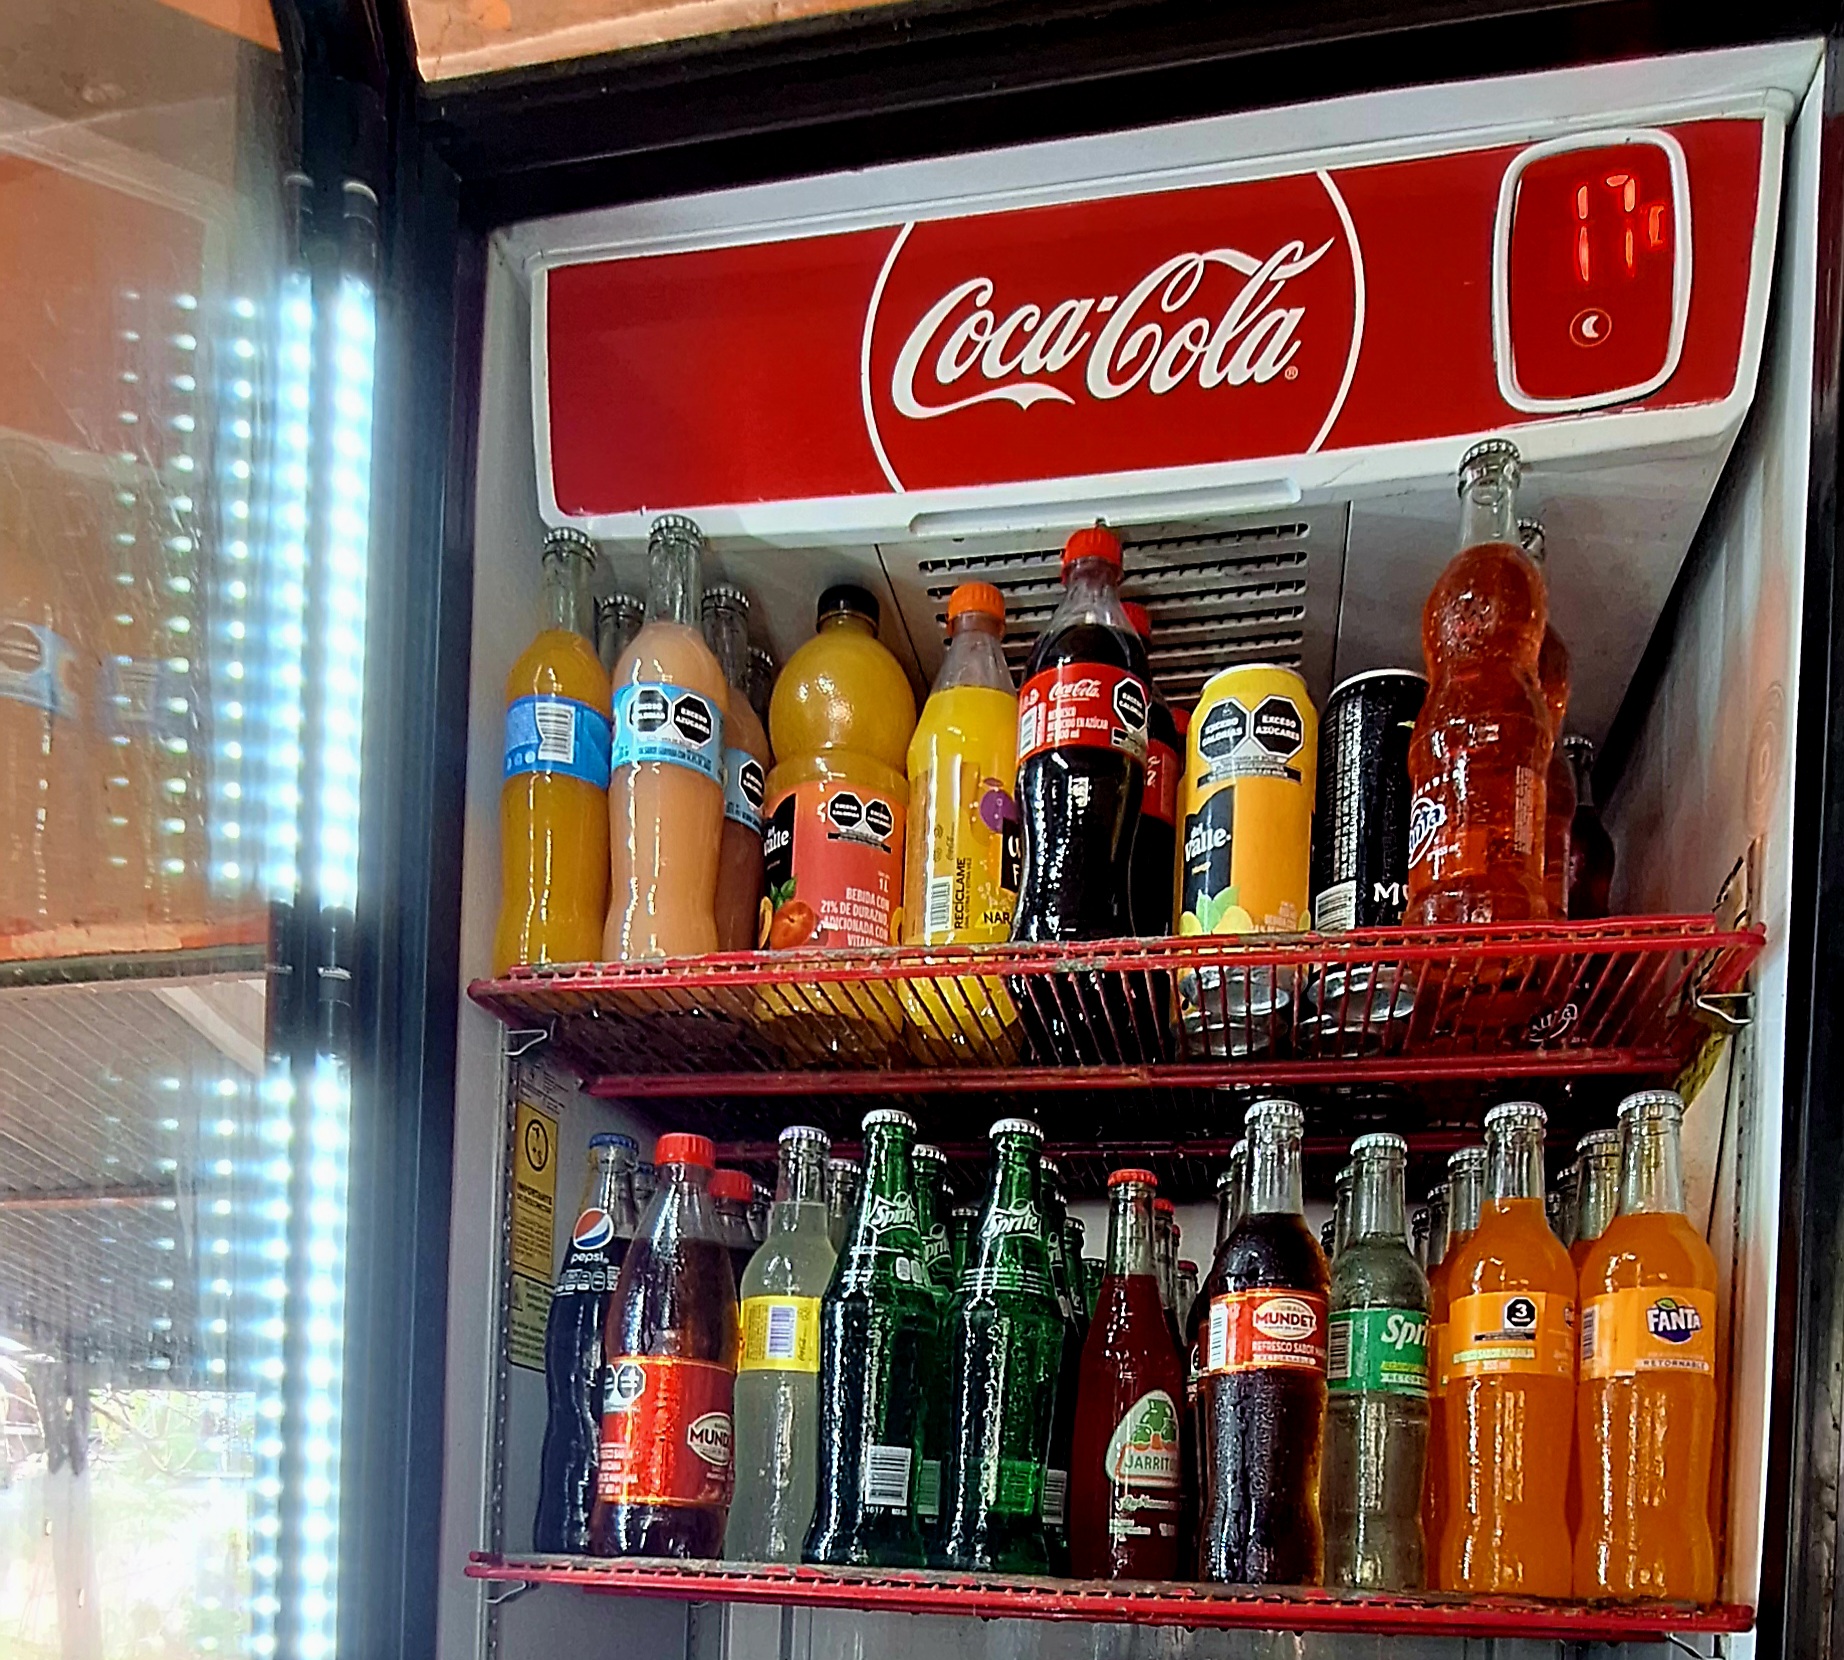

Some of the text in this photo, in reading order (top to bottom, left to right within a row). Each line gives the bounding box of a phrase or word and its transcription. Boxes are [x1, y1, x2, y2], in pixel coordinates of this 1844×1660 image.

[1577, 174, 1636, 283] 17
[891, 236, 1336, 418] Coca-Cola
[1204, 716, 1240, 736] EXCESO
[1261, 714, 1297, 729] EXCESO
[1255, 724, 1301, 742] AZÚCARES
[820, 899, 839, 914] 21%
[839, 901, 852, 915] DE
[845, 887, 891, 911] BEBIDA CON
[870, 1203, 917, 1228] Sprite
[983, 1211, 1040, 1243] Sprite
[570, 1251, 606, 1265] pepsi
[1514, 1302, 1529, 1318] 3
[1255, 1311, 1316, 1329] MUNDET
[1646, 1307, 1702, 1332] FANTA
[1252, 1341, 1293, 1353] REFRESCO
[1293, 1342, 1315, 1355] SABOR
[1642, 1359, 1707, 1370] RETORNABLE
